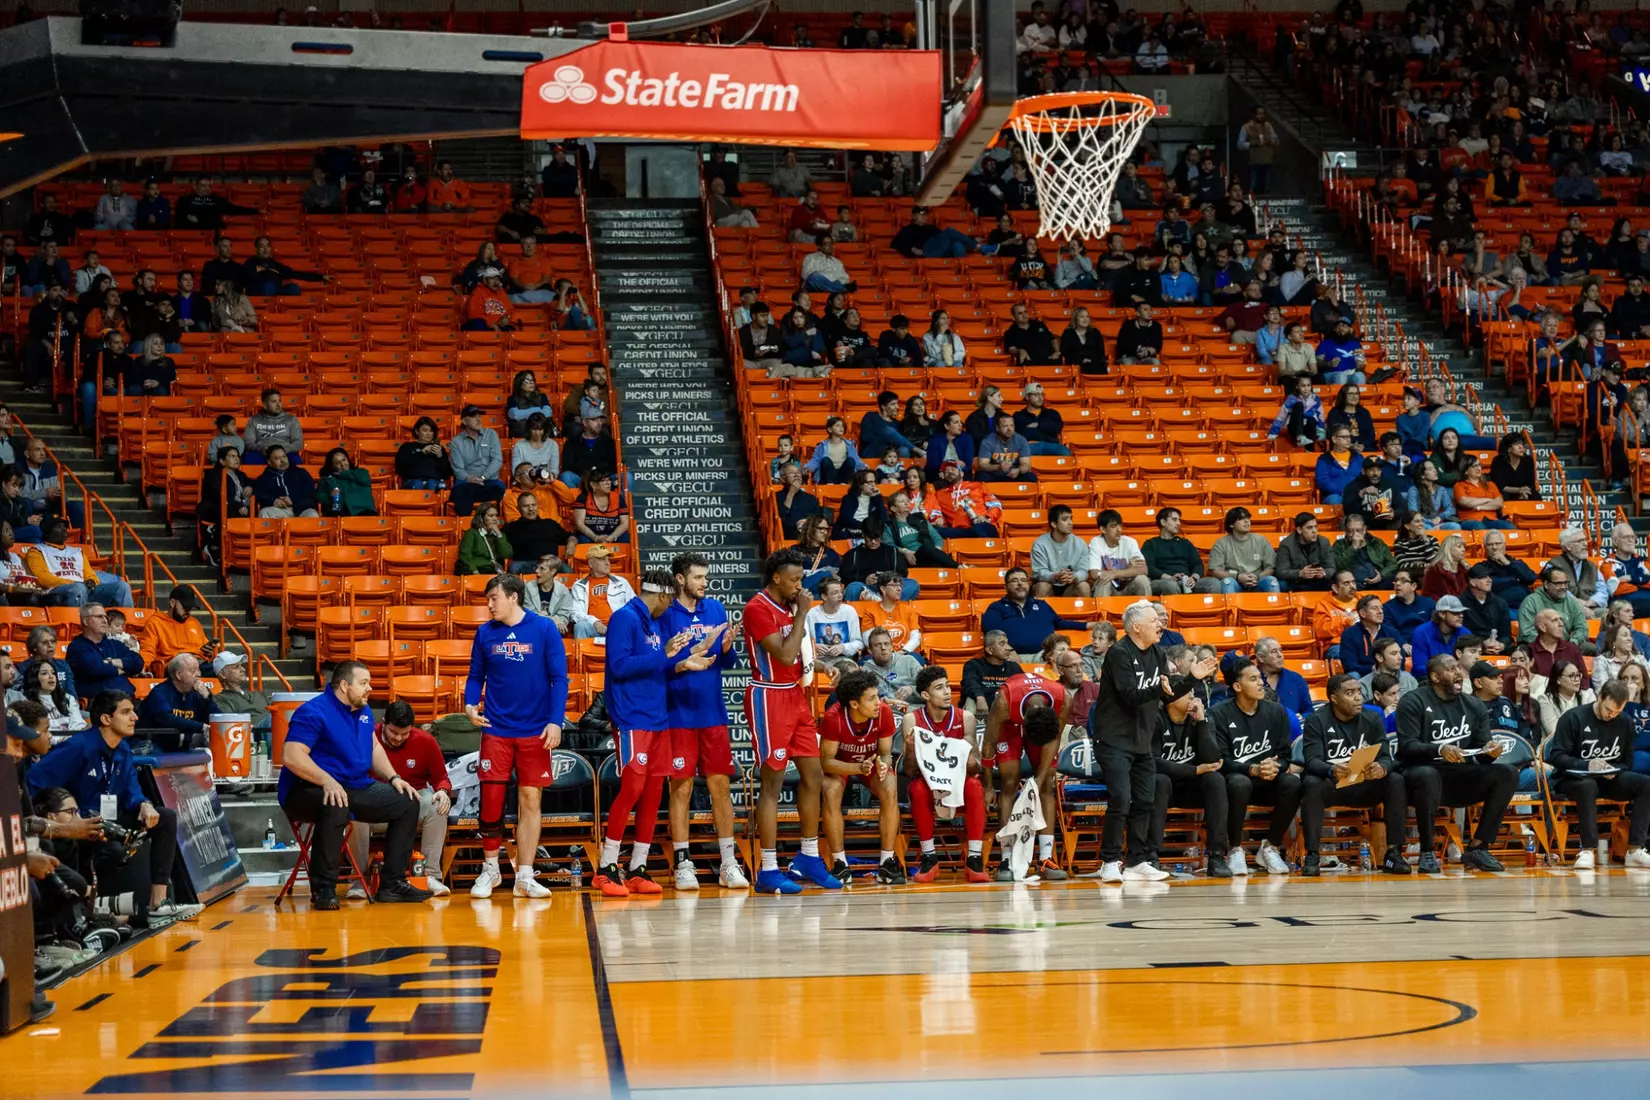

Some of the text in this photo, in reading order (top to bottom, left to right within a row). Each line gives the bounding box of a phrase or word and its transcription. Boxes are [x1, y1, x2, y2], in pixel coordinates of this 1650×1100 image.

[648, 332, 684, 340] GECU
[654, 369, 692, 378] GECU
[625, 391, 654, 399] PICKS
[672, 391, 712, 399] MINERS!
[637, 412, 710, 421] THE OFFICIAL
[626, 434, 724, 444] OF UTEP ATHLETICS
[637, 459, 723, 468] WE'RE WITH YOU
[634, 472, 666, 481] PICKS
[685, 472, 728, 480] MINERS!
[672, 482, 714, 493] GECU
[645, 497, 725, 506] THE OFFICIAL
[644, 508, 732, 519] CREDIT UNION
[637, 523, 742, 533] OF UTEP ATHLETICS
[680, 535, 726, 546] GECU
[718, 551, 742, 560] YOU
[707, 564, 749, 573] MINERS!
[1136, 667, 1160, 690] Tech
[228, 726, 243, 742] G
[1430, 714, 1471, 744] Tech
[1232, 730, 1271, 764] Tech
[1581, 736, 1621, 760] Tech
